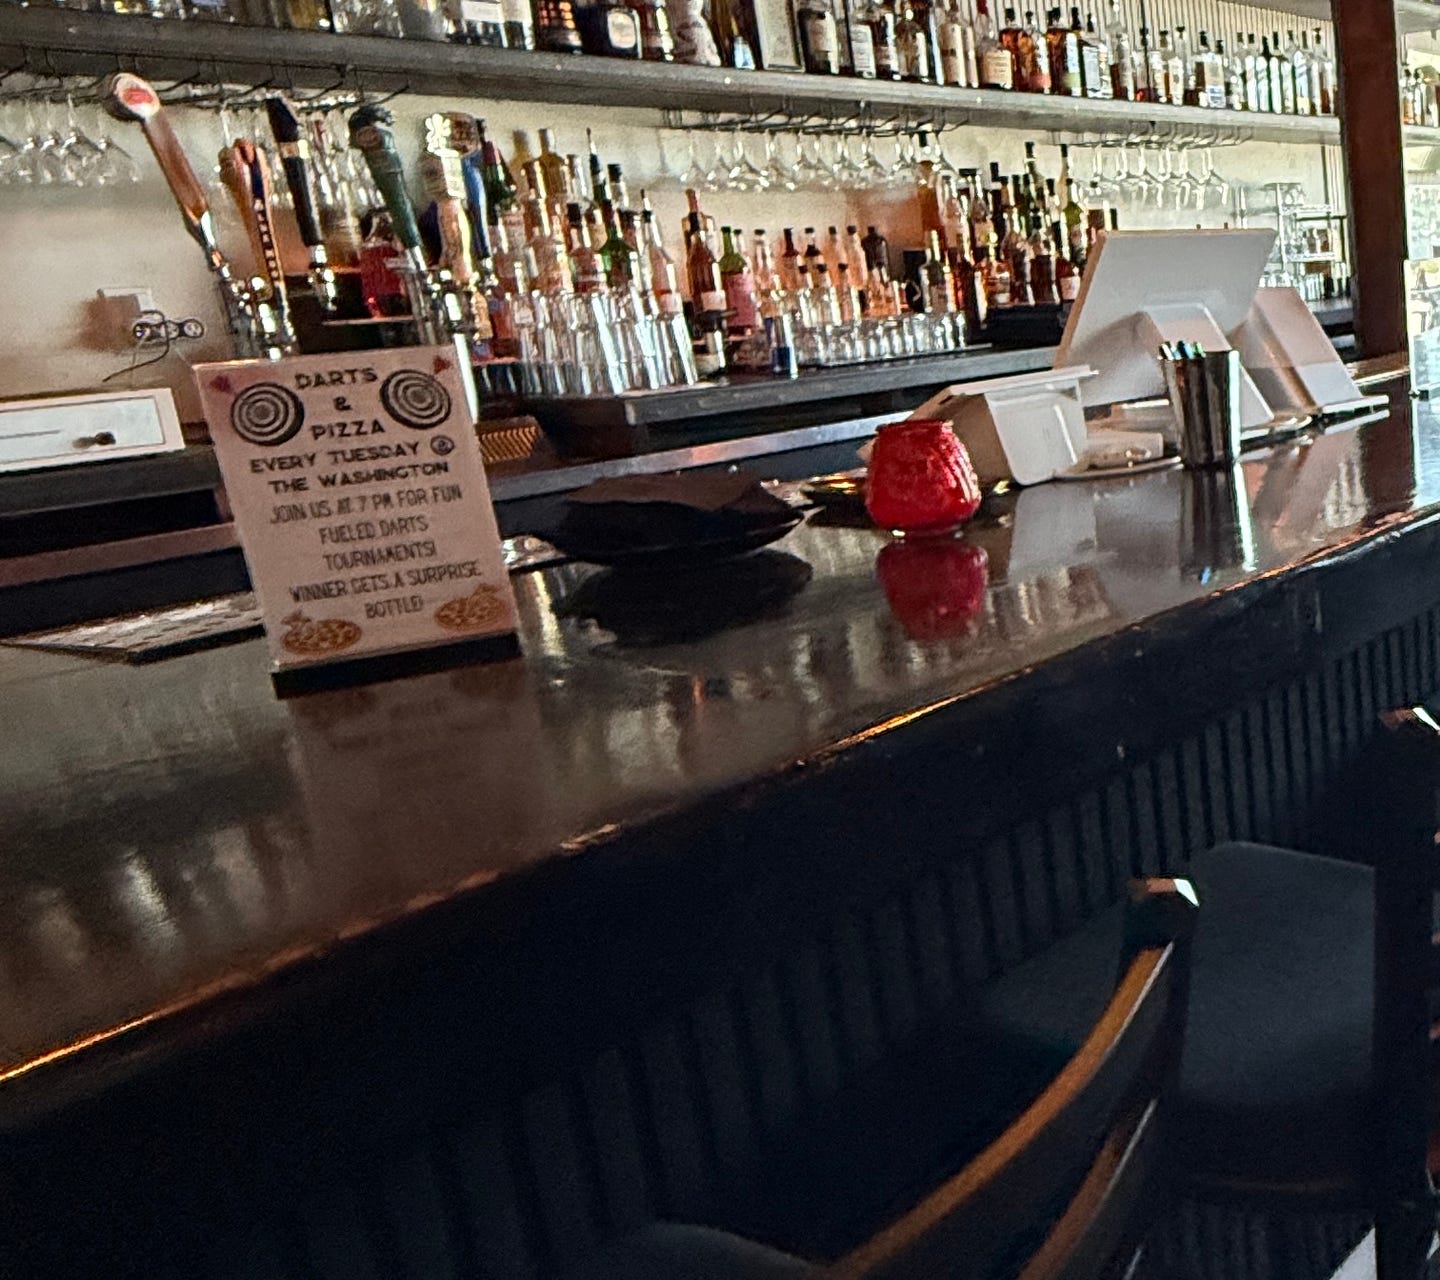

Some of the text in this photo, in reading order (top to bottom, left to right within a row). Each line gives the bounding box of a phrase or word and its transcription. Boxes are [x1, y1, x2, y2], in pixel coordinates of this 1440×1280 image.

[295, 367, 379, 389] DARTS
[333, 397, 351, 412] &
[310, 419, 385, 440] PIZZA
[250, 453, 316, 473] EVERY
[327, 442, 419, 465] TUESDAY
[268, 461, 449, 494] THE WASHINGTON
[270, 504, 307, 524] JOIN
[308, 500, 332, 518] US
[372, 493, 394, 510] PM
[397, 488, 427, 508] FOR
[432, 484, 463, 502] FUN
[319, 515, 429, 545] FUELED DARTS
[322, 540, 438, 571] TOURNAMENTS!
[289, 560, 483, 604] WINNER GETS A SURPRISE
